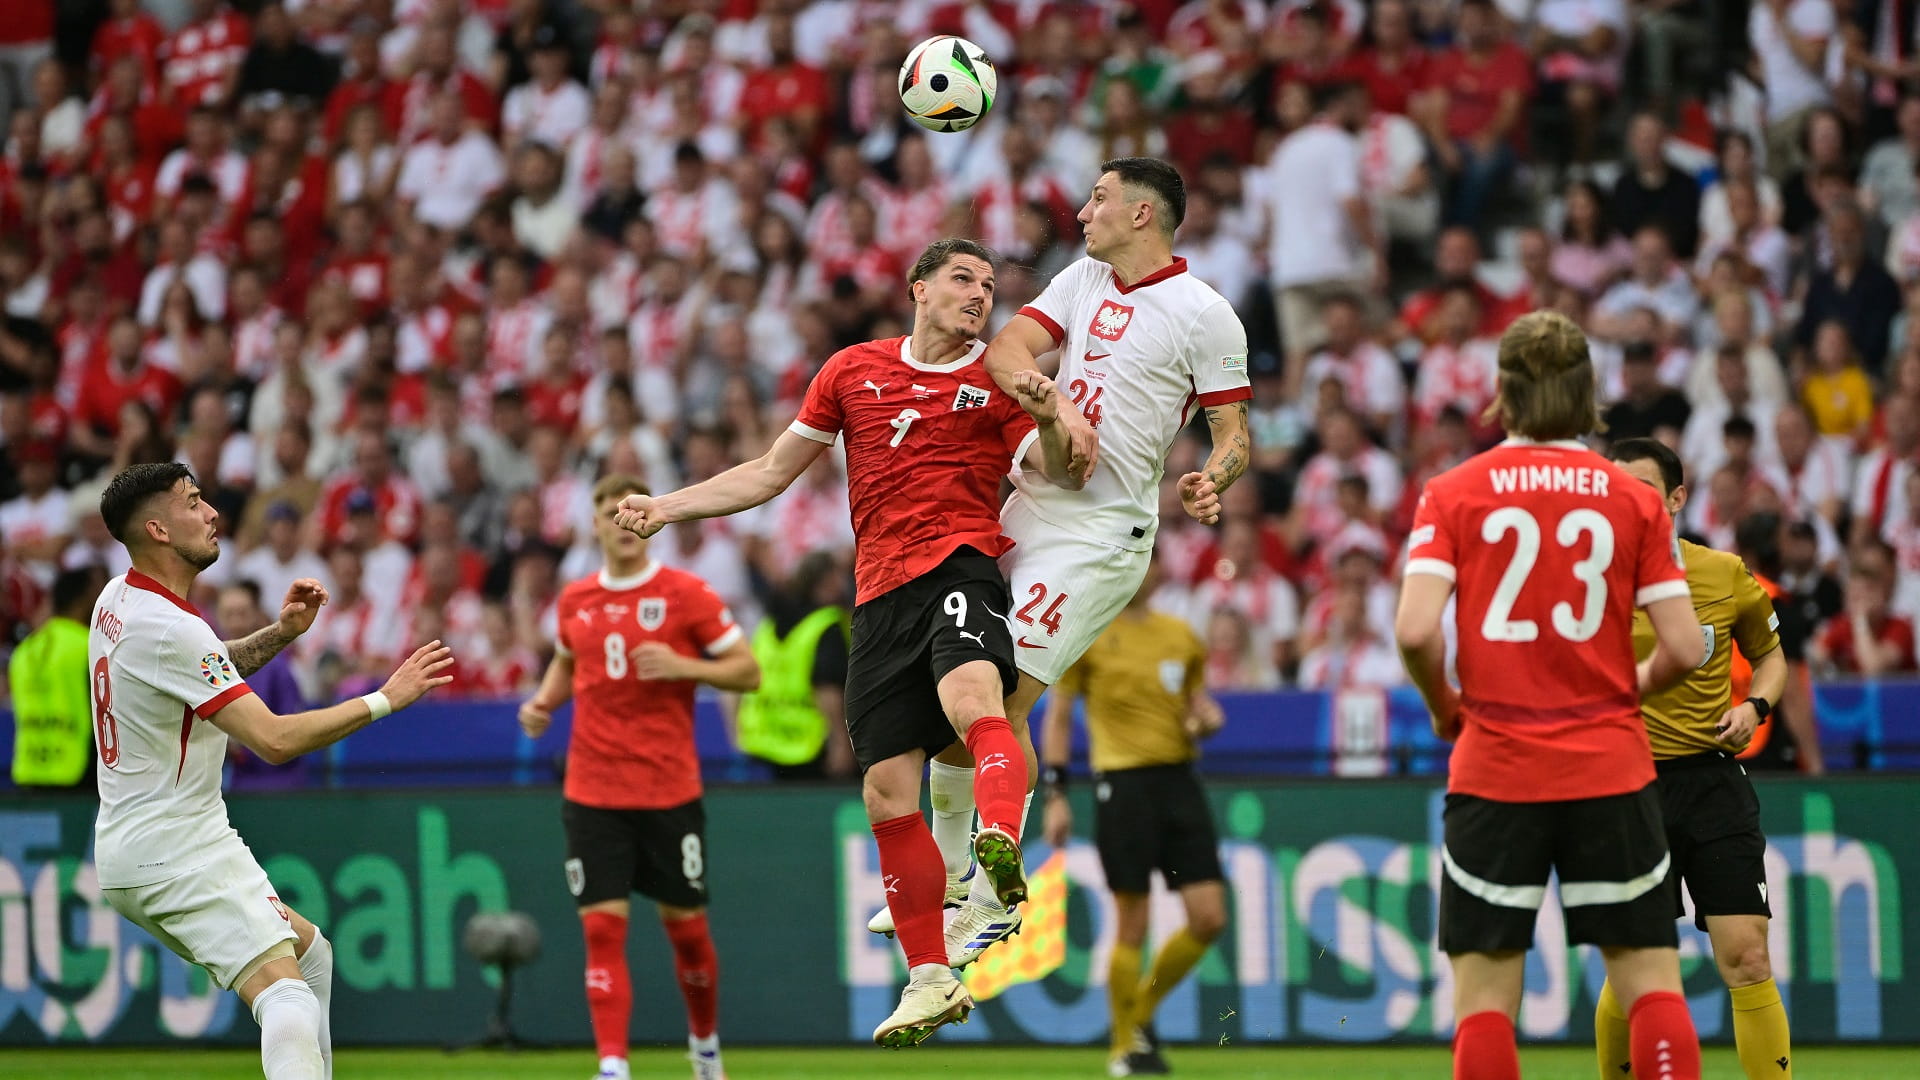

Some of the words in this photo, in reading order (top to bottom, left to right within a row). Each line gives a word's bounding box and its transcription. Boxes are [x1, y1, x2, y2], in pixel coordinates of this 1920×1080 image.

[890, 409, 921, 447] 9
[1069, 379, 1104, 429] 24
[1489, 464, 1609, 497] WIMMER
[1481, 507, 1614, 642] 23
[944, 592, 967, 627] 9
[1016, 583, 1068, 637] 24
[604, 632, 627, 680] 8
[93, 656, 120, 768] 8
[681, 833, 703, 880] 8
